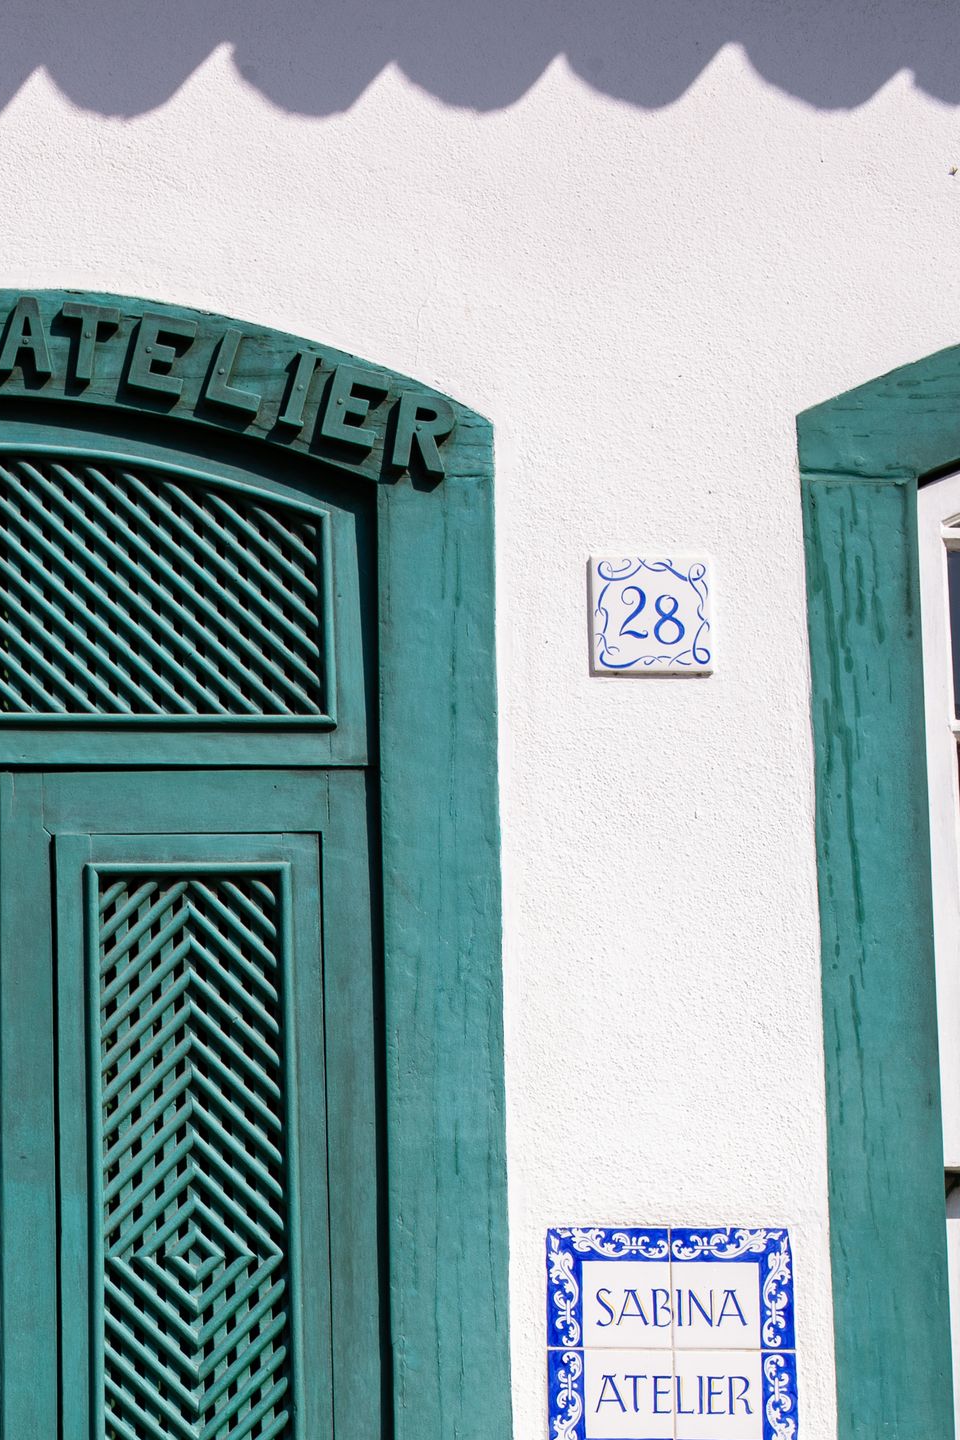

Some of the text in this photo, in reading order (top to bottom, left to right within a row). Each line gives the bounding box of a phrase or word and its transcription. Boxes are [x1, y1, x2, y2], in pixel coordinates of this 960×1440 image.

[619, 586, 685, 645] 28
[595, 1288, 748, 1328] SABINA
[595, 1373, 753, 1416] ATELIER
